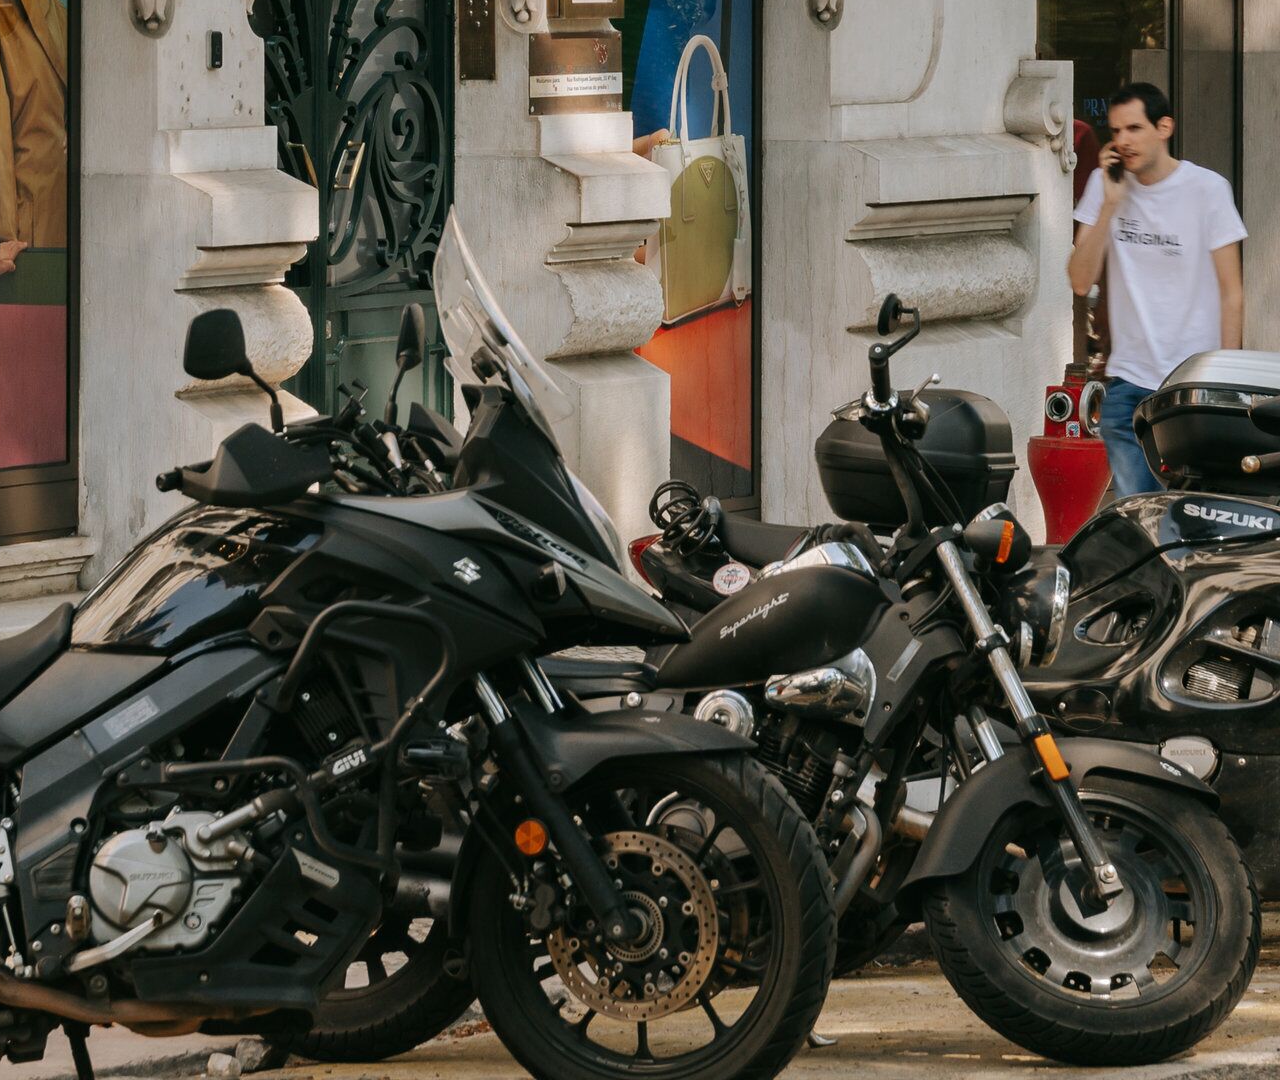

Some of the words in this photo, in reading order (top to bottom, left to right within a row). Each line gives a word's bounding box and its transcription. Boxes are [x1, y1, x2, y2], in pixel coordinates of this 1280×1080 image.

[1083, 98, 1112, 118] PRA
[1182, 502, 1274, 531] SUZUKI
[720, 592, 790, 639] Superlight
[332, 748, 367, 776] GIVI
